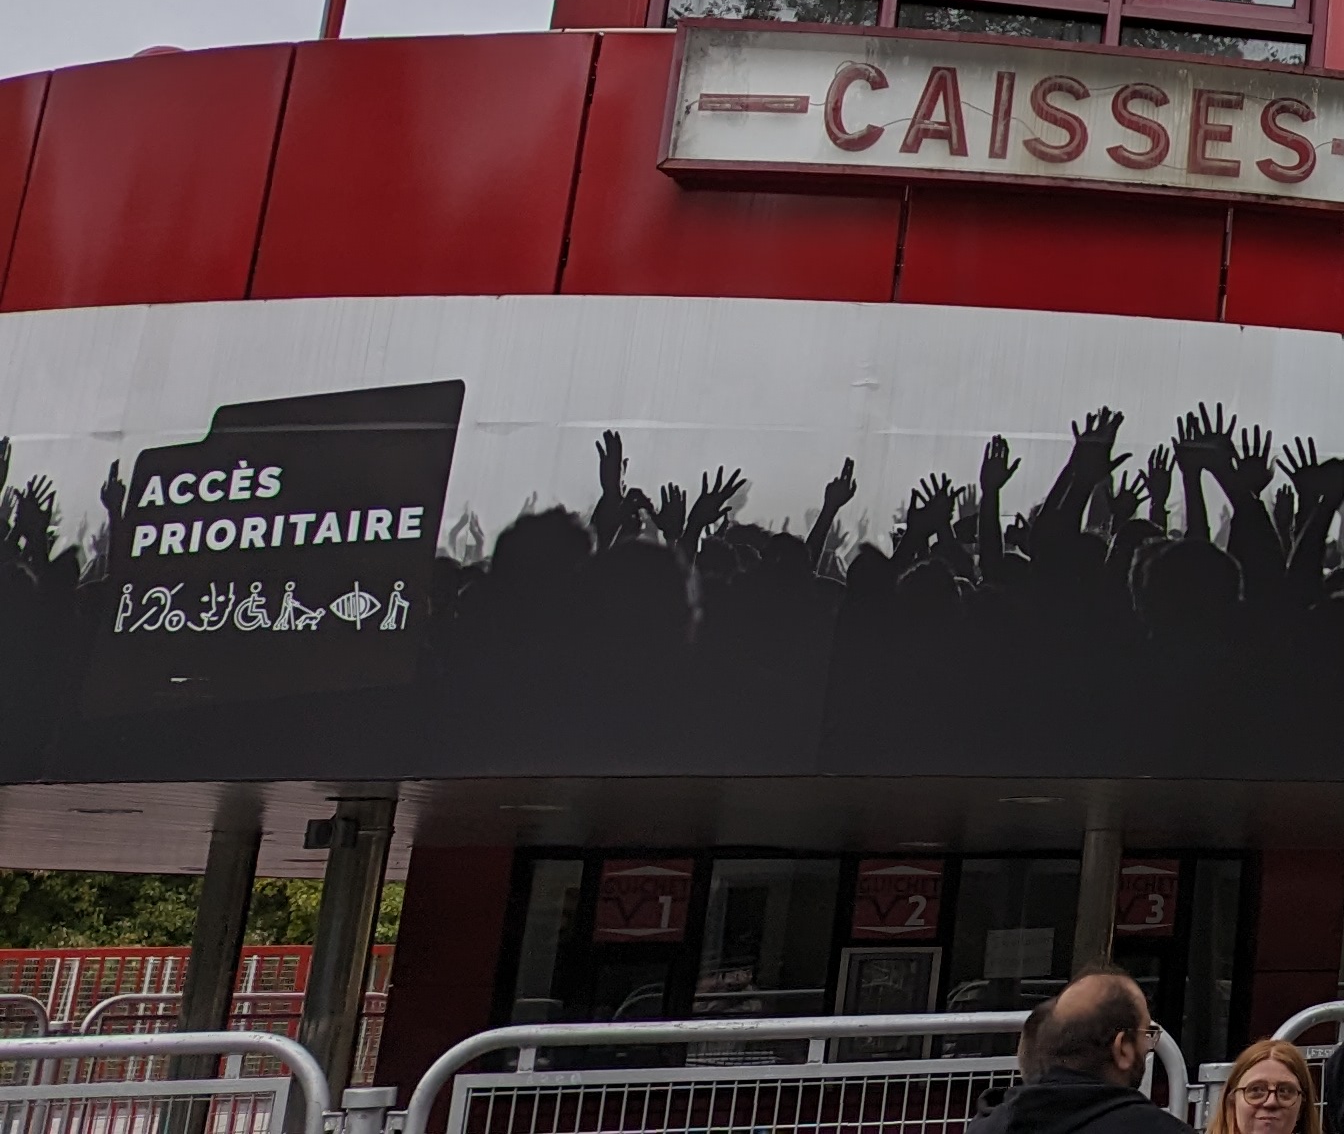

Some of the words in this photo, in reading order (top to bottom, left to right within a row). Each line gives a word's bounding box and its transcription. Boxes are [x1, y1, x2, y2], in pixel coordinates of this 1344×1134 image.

[823, 60, 1318, 184] CAISSES
[138, 460, 283, 507] ACCÈS
[131, 506, 425, 557] PRIORITAIRE
[659, 895, 673, 929] 1
[904, 895, 927, 926] 2
[1145, 893, 1165, 924] 3
